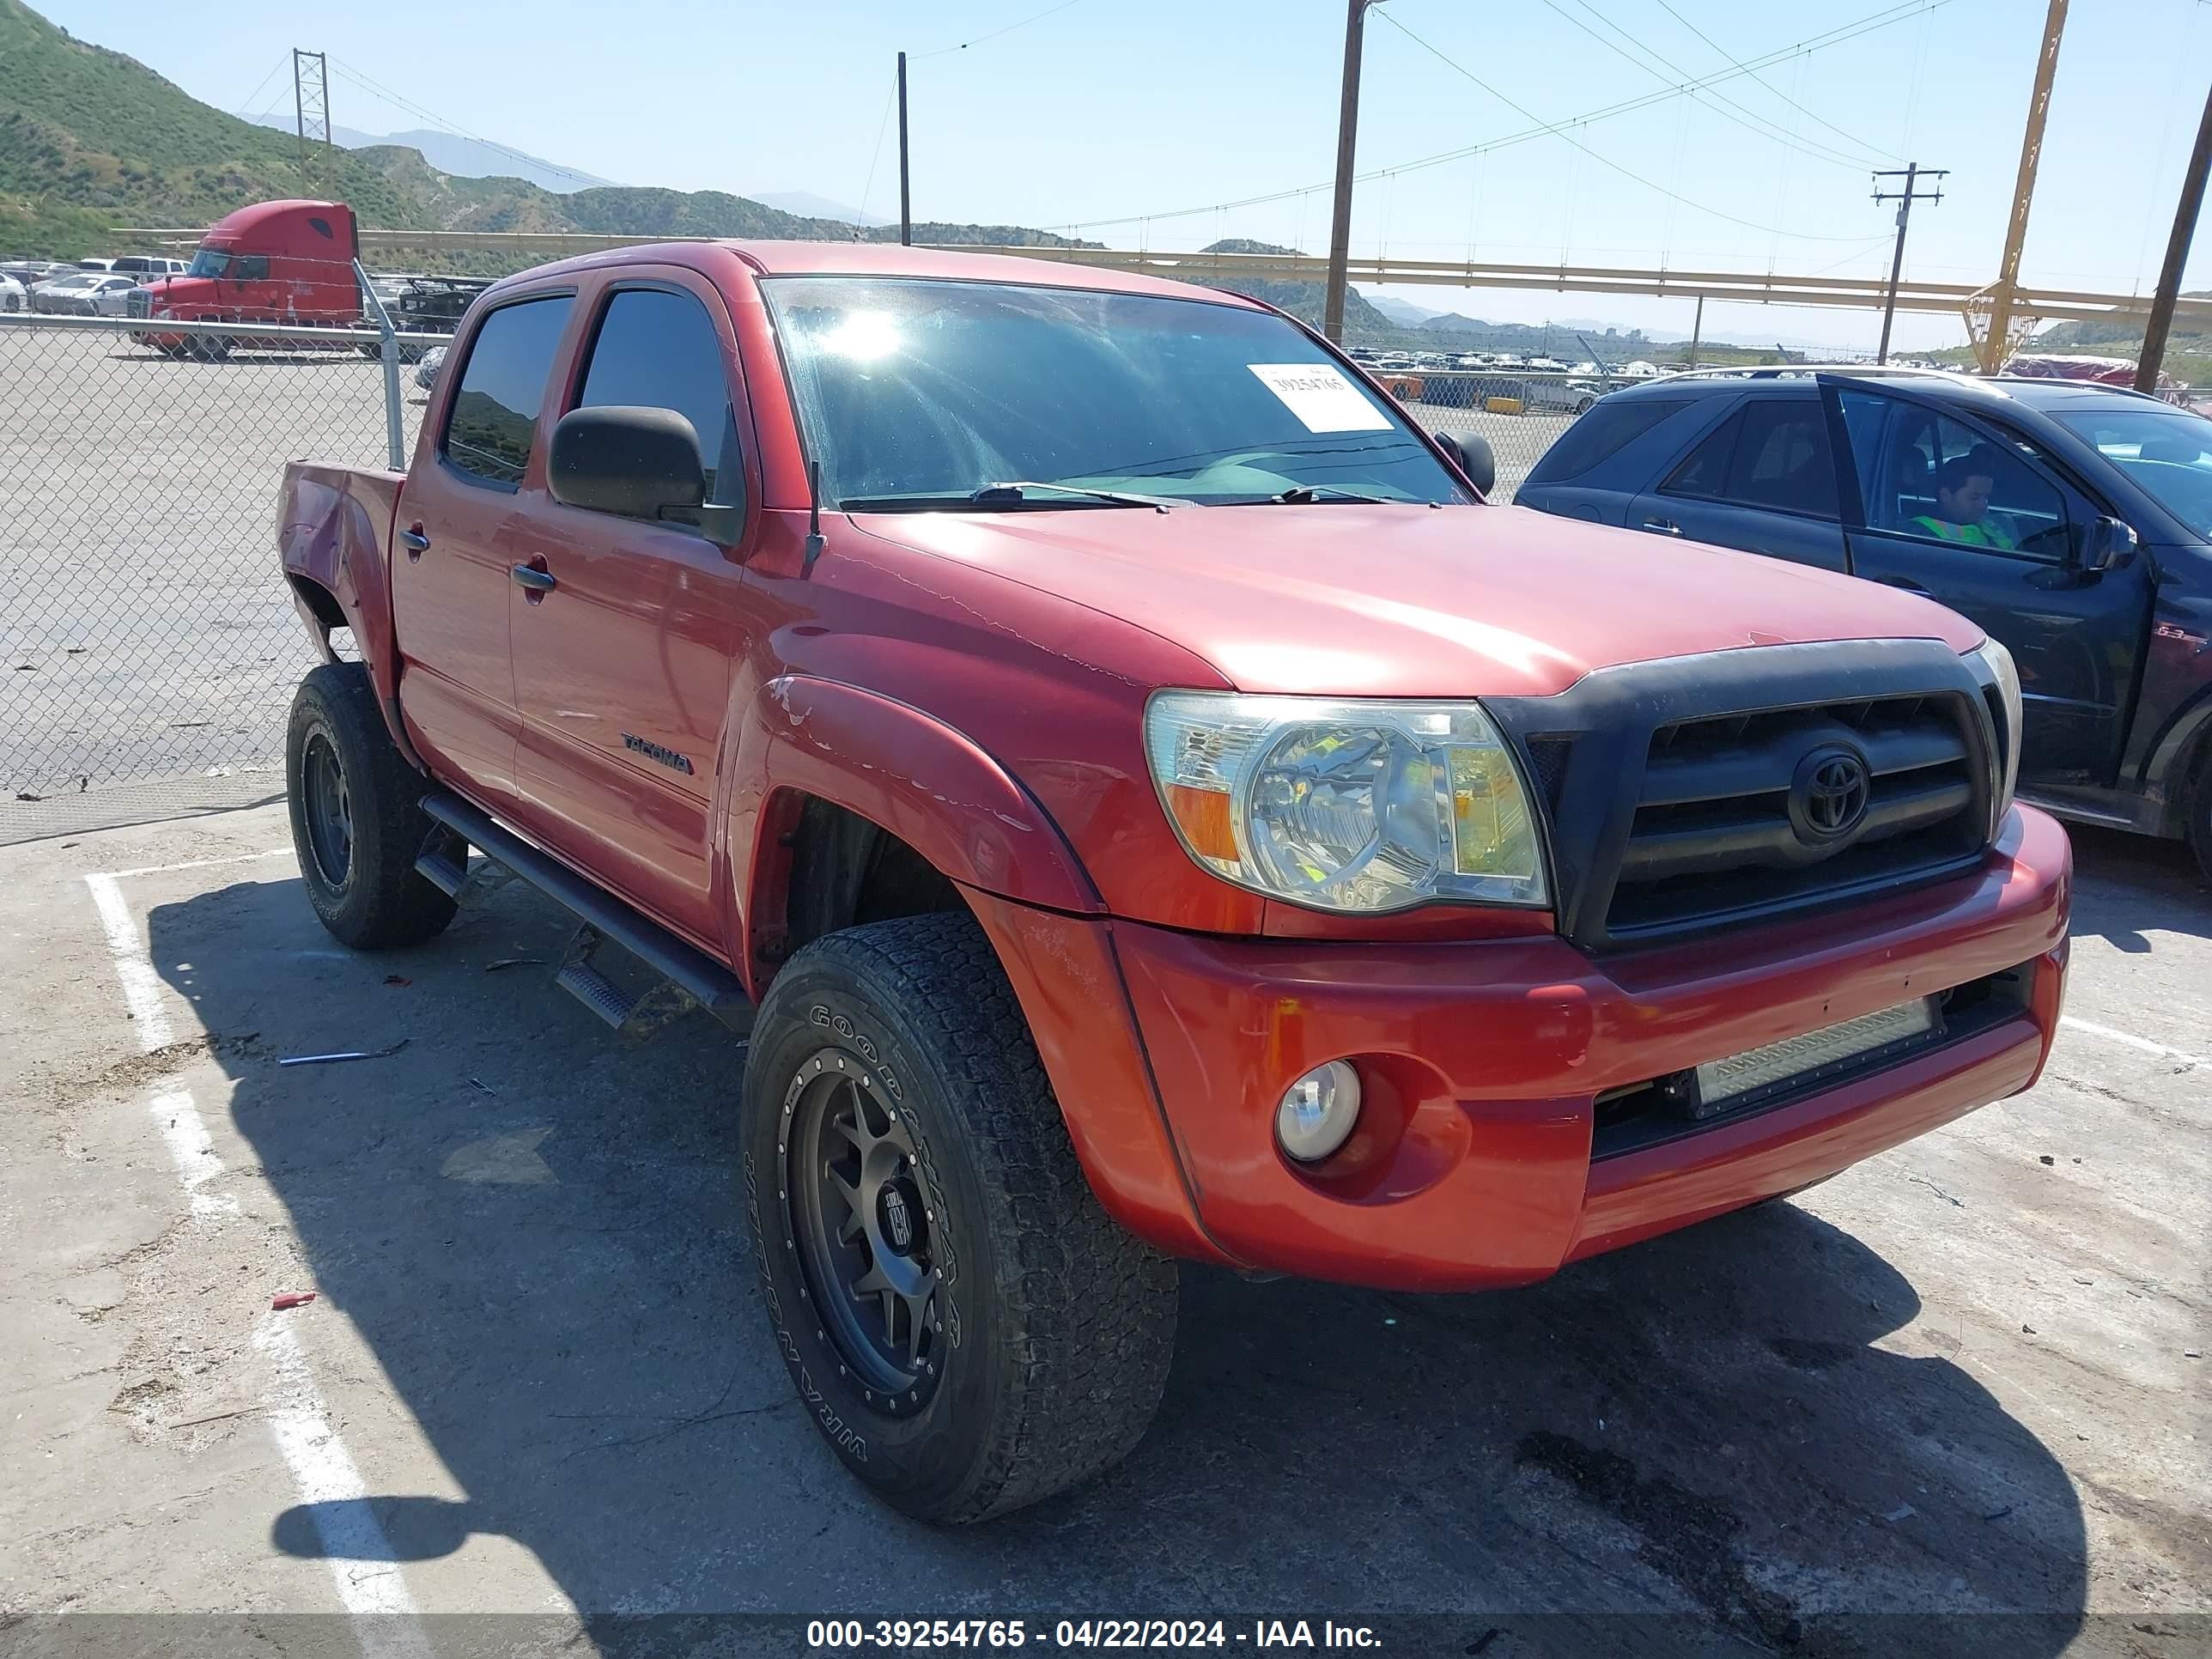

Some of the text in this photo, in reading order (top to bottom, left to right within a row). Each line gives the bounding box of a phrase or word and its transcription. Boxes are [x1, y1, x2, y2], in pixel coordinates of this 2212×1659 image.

[1273, 378, 1345, 392] 39254765
[621, 730, 695, 775] TACOMA
[744, 1151, 868, 1462] WRANGLER
